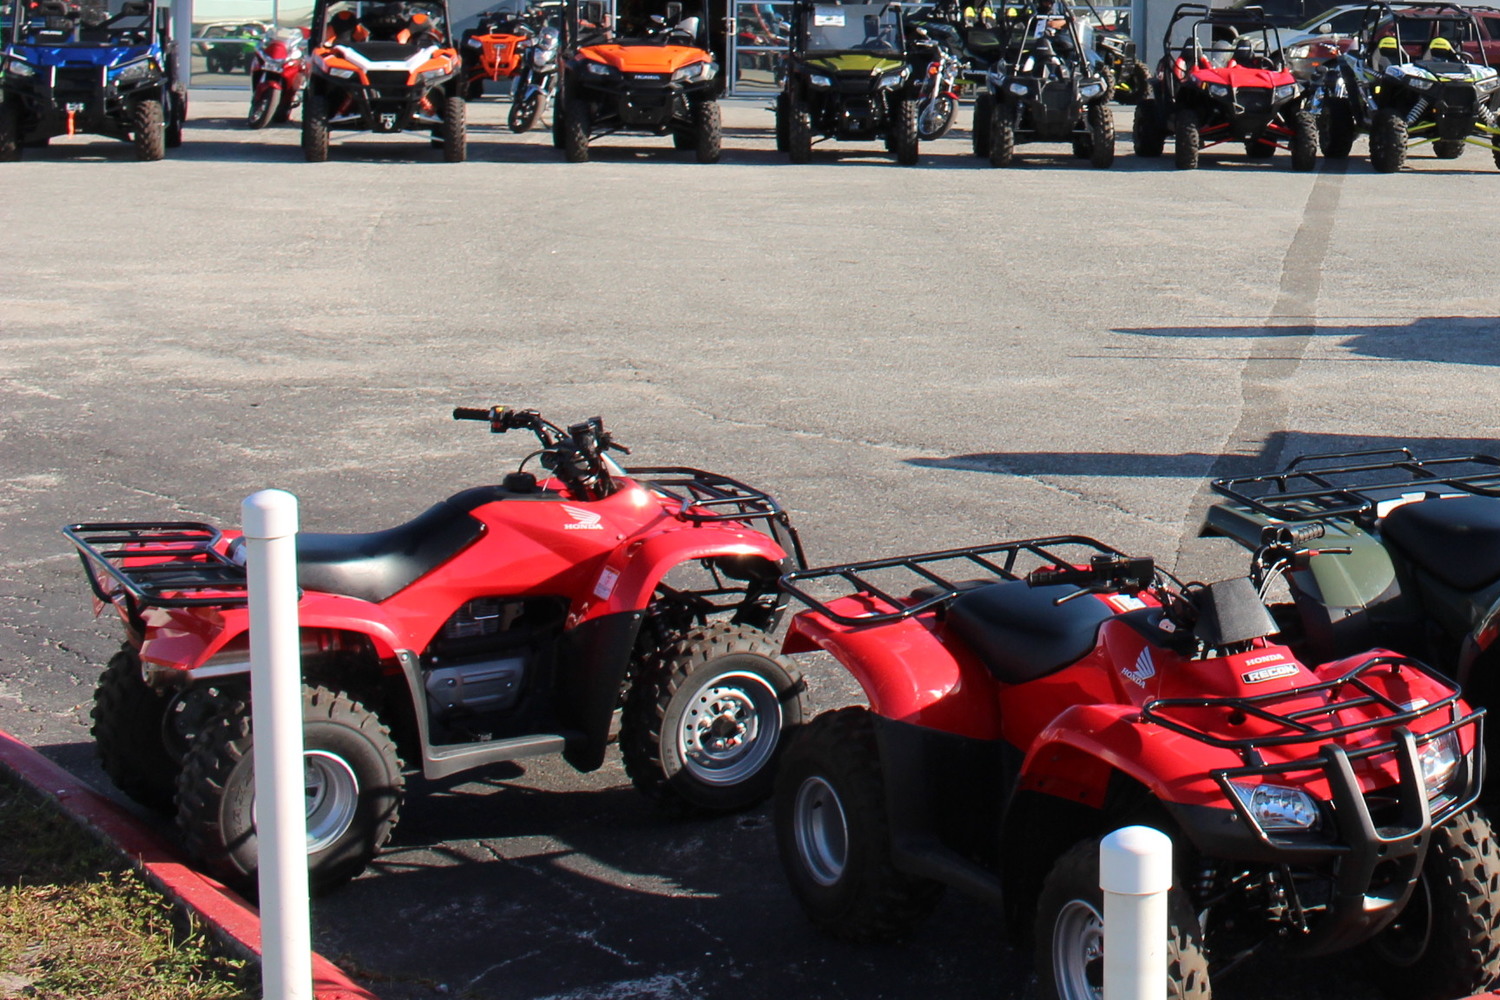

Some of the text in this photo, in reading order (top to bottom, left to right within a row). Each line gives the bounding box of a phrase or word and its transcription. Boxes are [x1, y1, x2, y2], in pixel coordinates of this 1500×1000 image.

[1245, 653, 1285, 667] HONDA
[1122, 667, 1146, 689] HONDA
[1249, 664, 1296, 682] RECON
